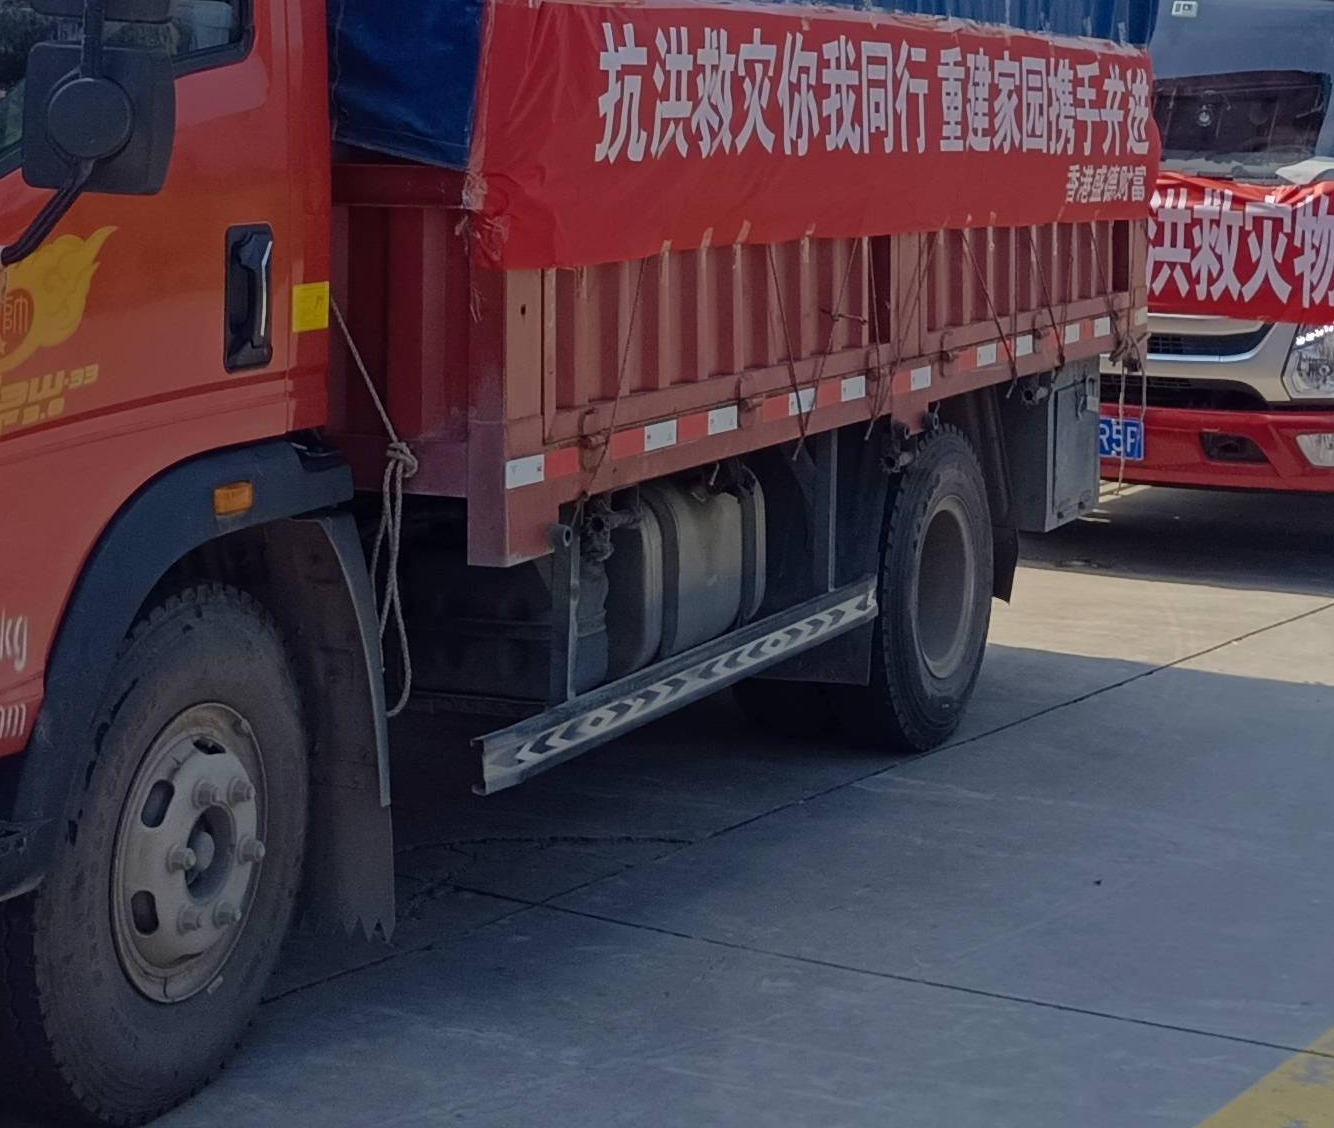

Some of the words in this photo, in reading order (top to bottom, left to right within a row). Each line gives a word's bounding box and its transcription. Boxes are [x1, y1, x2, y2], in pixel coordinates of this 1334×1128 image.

[595, 22, 928, 164] 抗洪救灾你我同行
[937, 47, 1149, 157] 重建家园携手并进
[1065, 164, 1147, 204] 香港盛德财富
